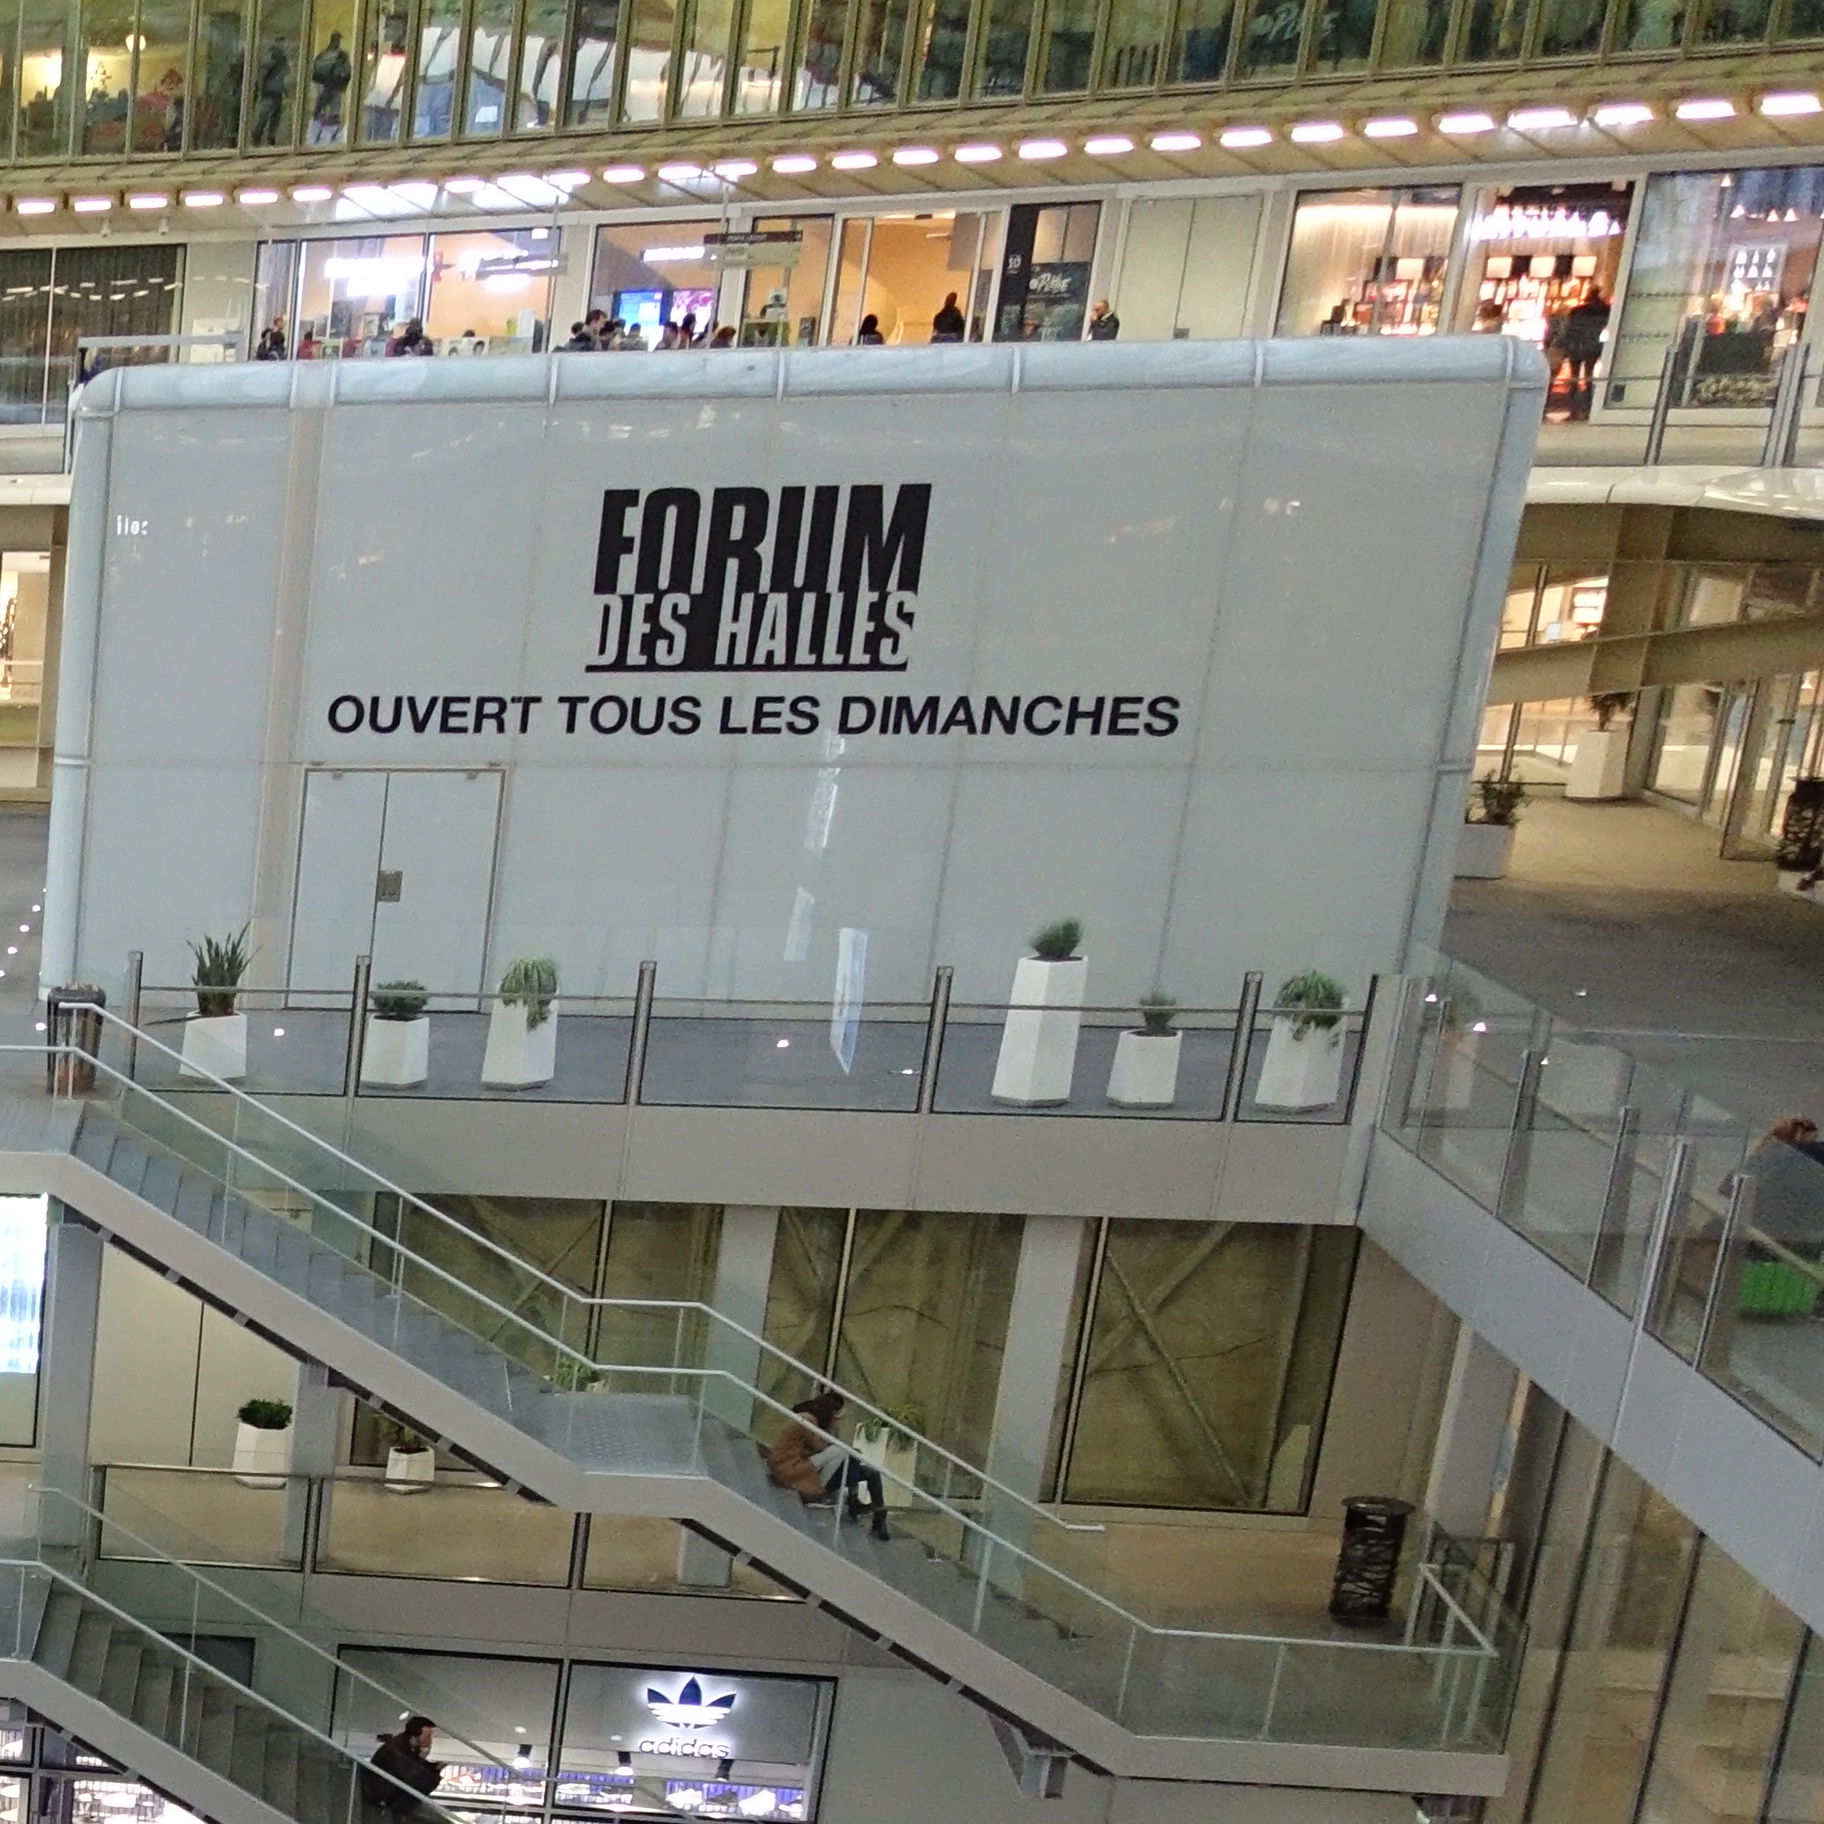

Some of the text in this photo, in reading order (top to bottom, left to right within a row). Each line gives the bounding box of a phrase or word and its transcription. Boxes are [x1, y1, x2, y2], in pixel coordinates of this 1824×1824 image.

[593, 484, 932, 594] FORUM
[587, 592, 917, 667] DES HALLES
[327, 694, 1180, 737] OUVERT TOUS LES DIMANCHES
[639, 1737, 729, 1759] adidas
